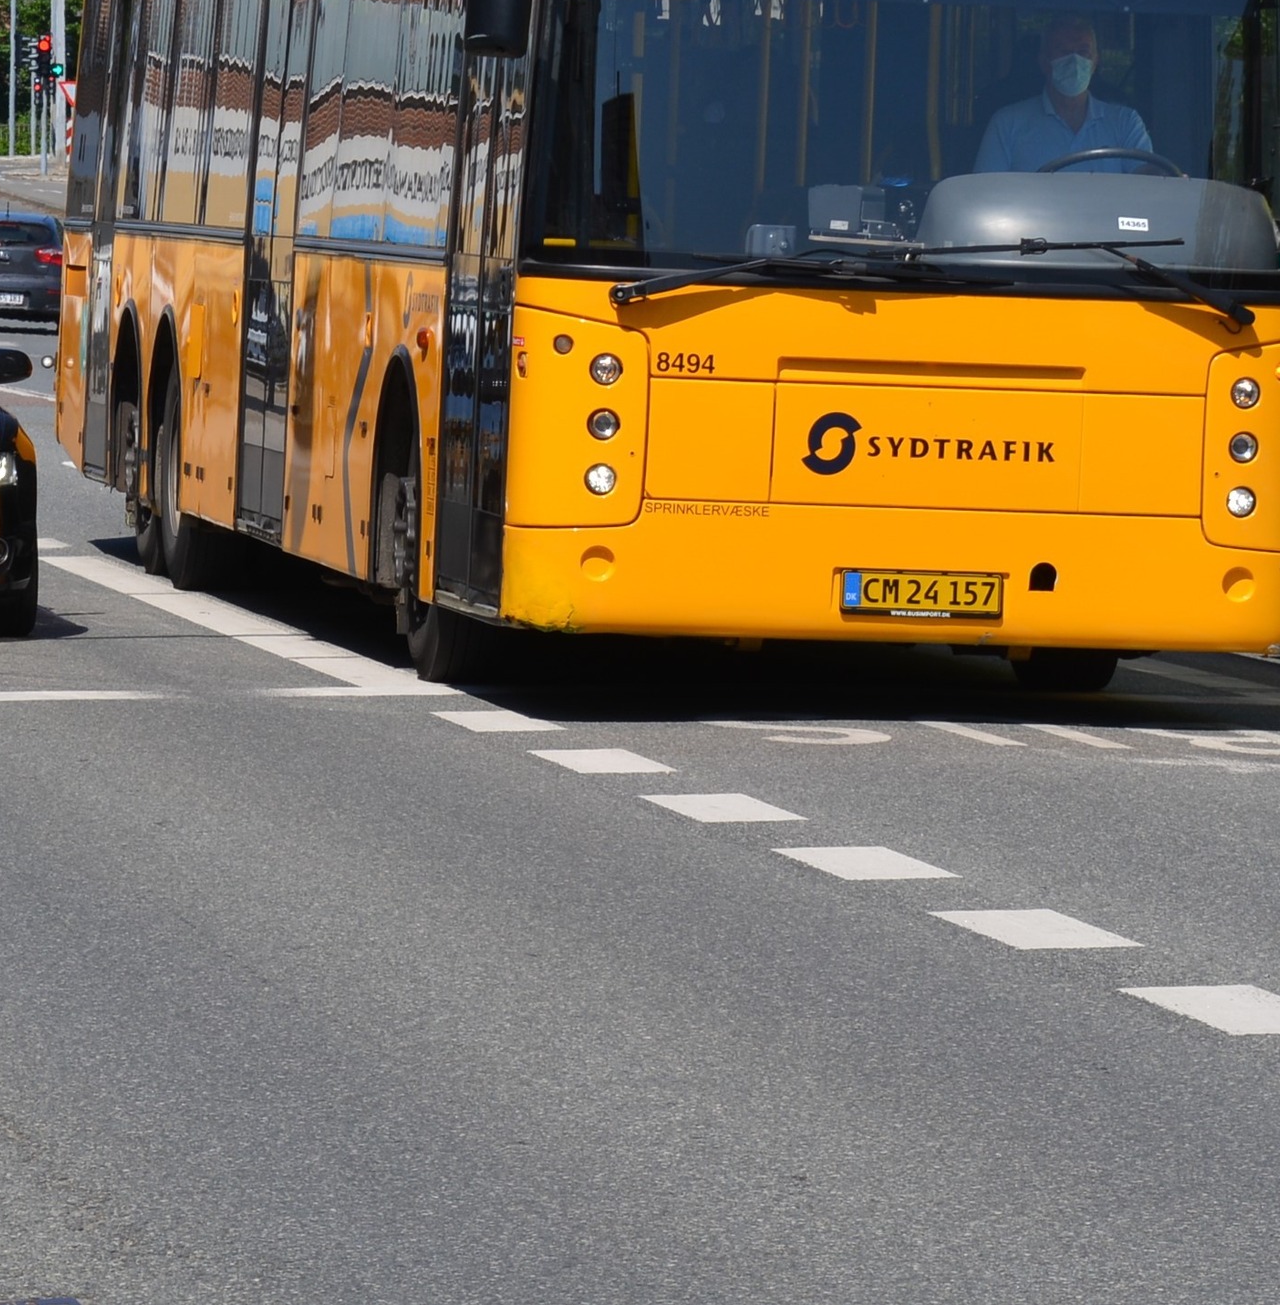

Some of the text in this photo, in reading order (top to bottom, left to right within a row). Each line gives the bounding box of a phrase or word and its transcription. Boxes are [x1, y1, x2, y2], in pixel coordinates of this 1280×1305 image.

[656, 352, 716, 374] 8494
[867, 436, 1056, 463] SYDTRAFIK
[644, 502, 770, 518] SPRINKLERVÆSKE
[845, 592, 857, 601] DK
[863, 578, 995, 606] CM 24 157
